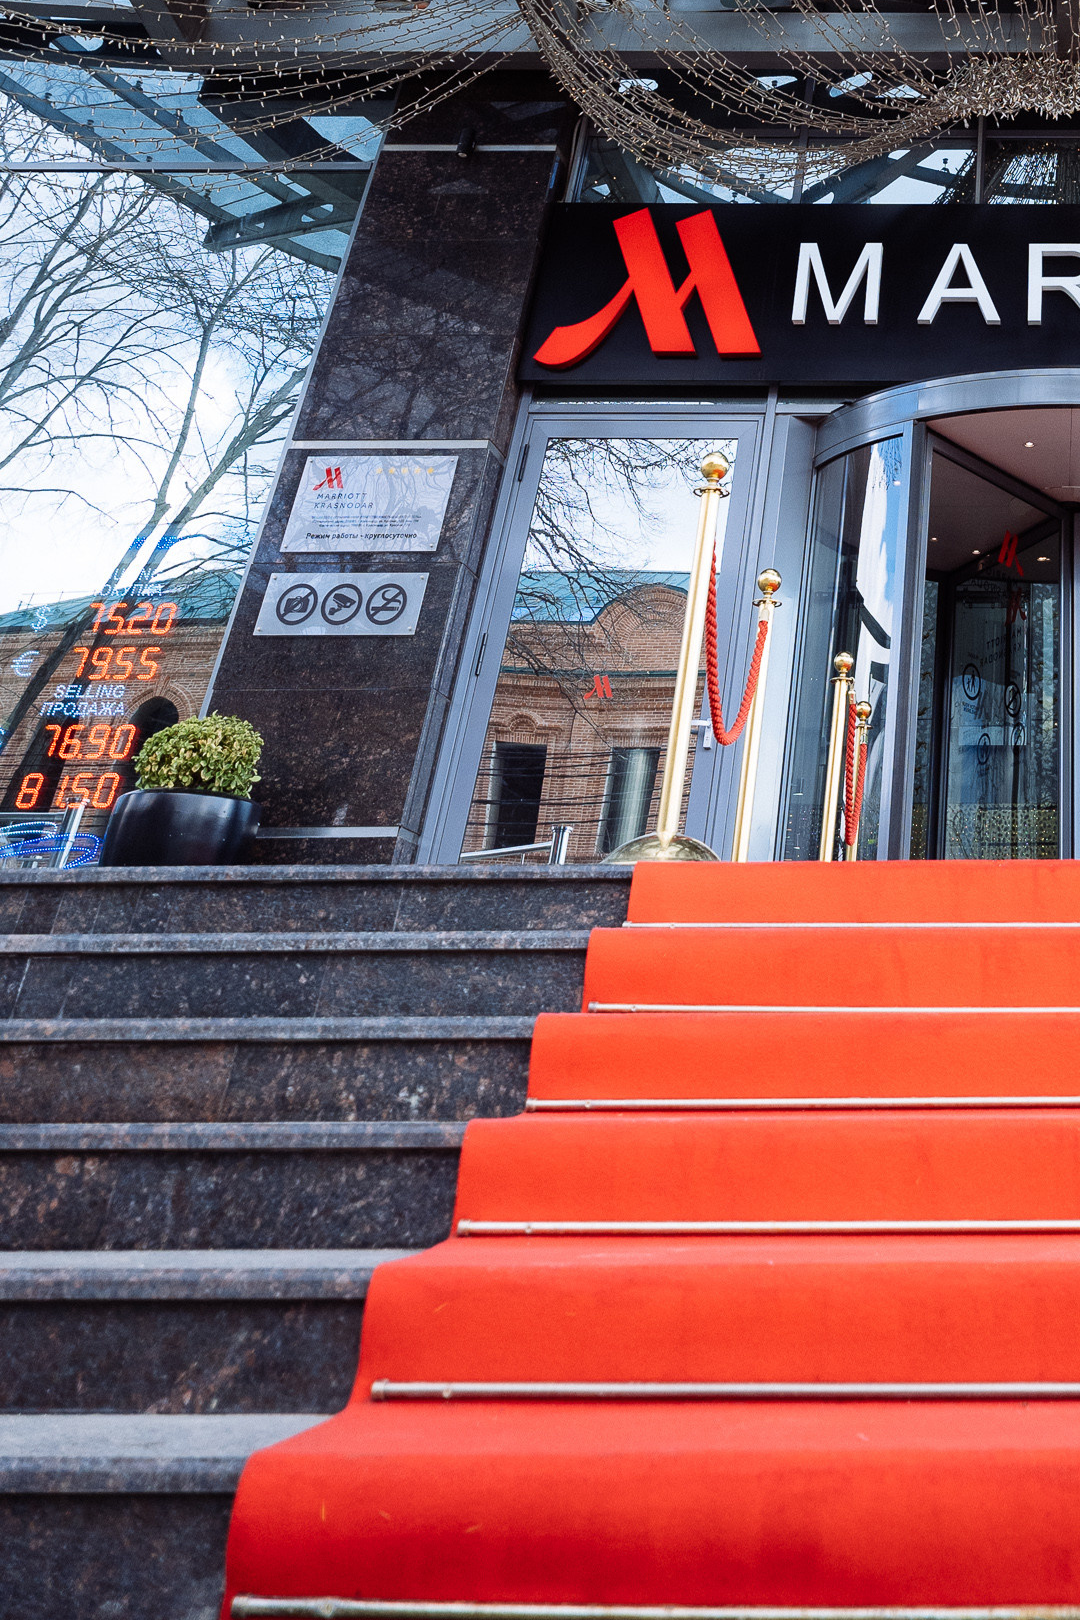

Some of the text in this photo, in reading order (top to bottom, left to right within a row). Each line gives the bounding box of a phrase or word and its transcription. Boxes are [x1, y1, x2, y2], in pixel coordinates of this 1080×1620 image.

[332, 532, 359, 540] работы
[364, 532, 418, 540] круглосуточно
[54, 684, 126, 699] SELLING
[39, 701, 125, 718] ПРОДАЖА
